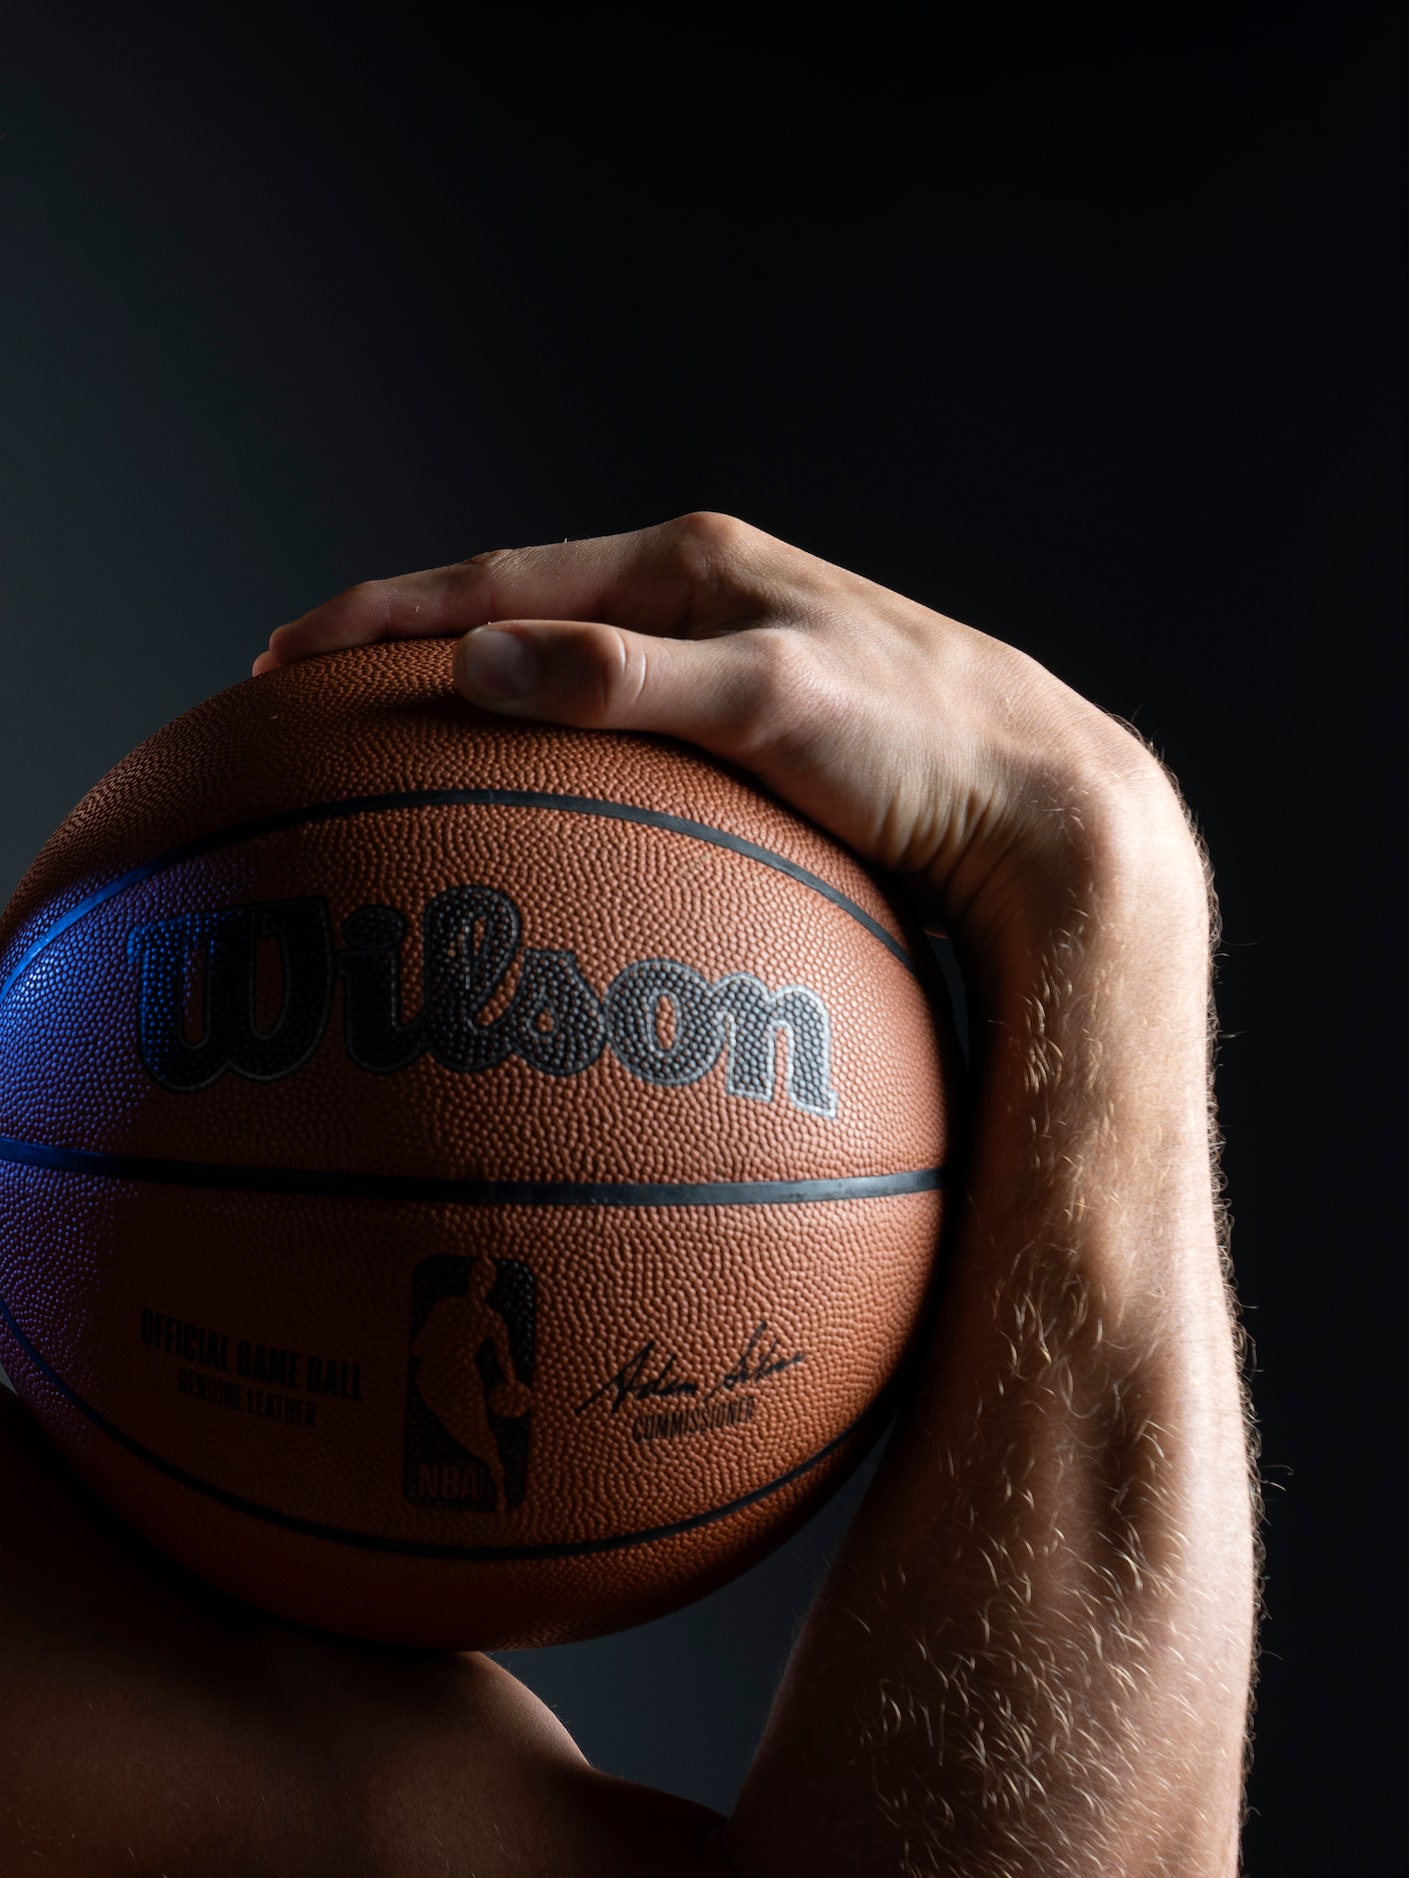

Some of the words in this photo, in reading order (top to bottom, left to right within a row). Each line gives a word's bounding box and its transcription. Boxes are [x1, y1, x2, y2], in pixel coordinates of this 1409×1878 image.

[125, 884, 838, 1118] Wilson
[140, 1307, 230, 1372] OFFICIAL
[237, 1339, 299, 1390] GAME
[306, 1355, 363, 1400] BALL
[178, 1366, 242, 1411] GENUINE
[247, 1387, 317, 1428] LEATHER
[633, 1396, 754, 1442] COMMISSIONER
[417, 1461, 479, 1500] NBA
